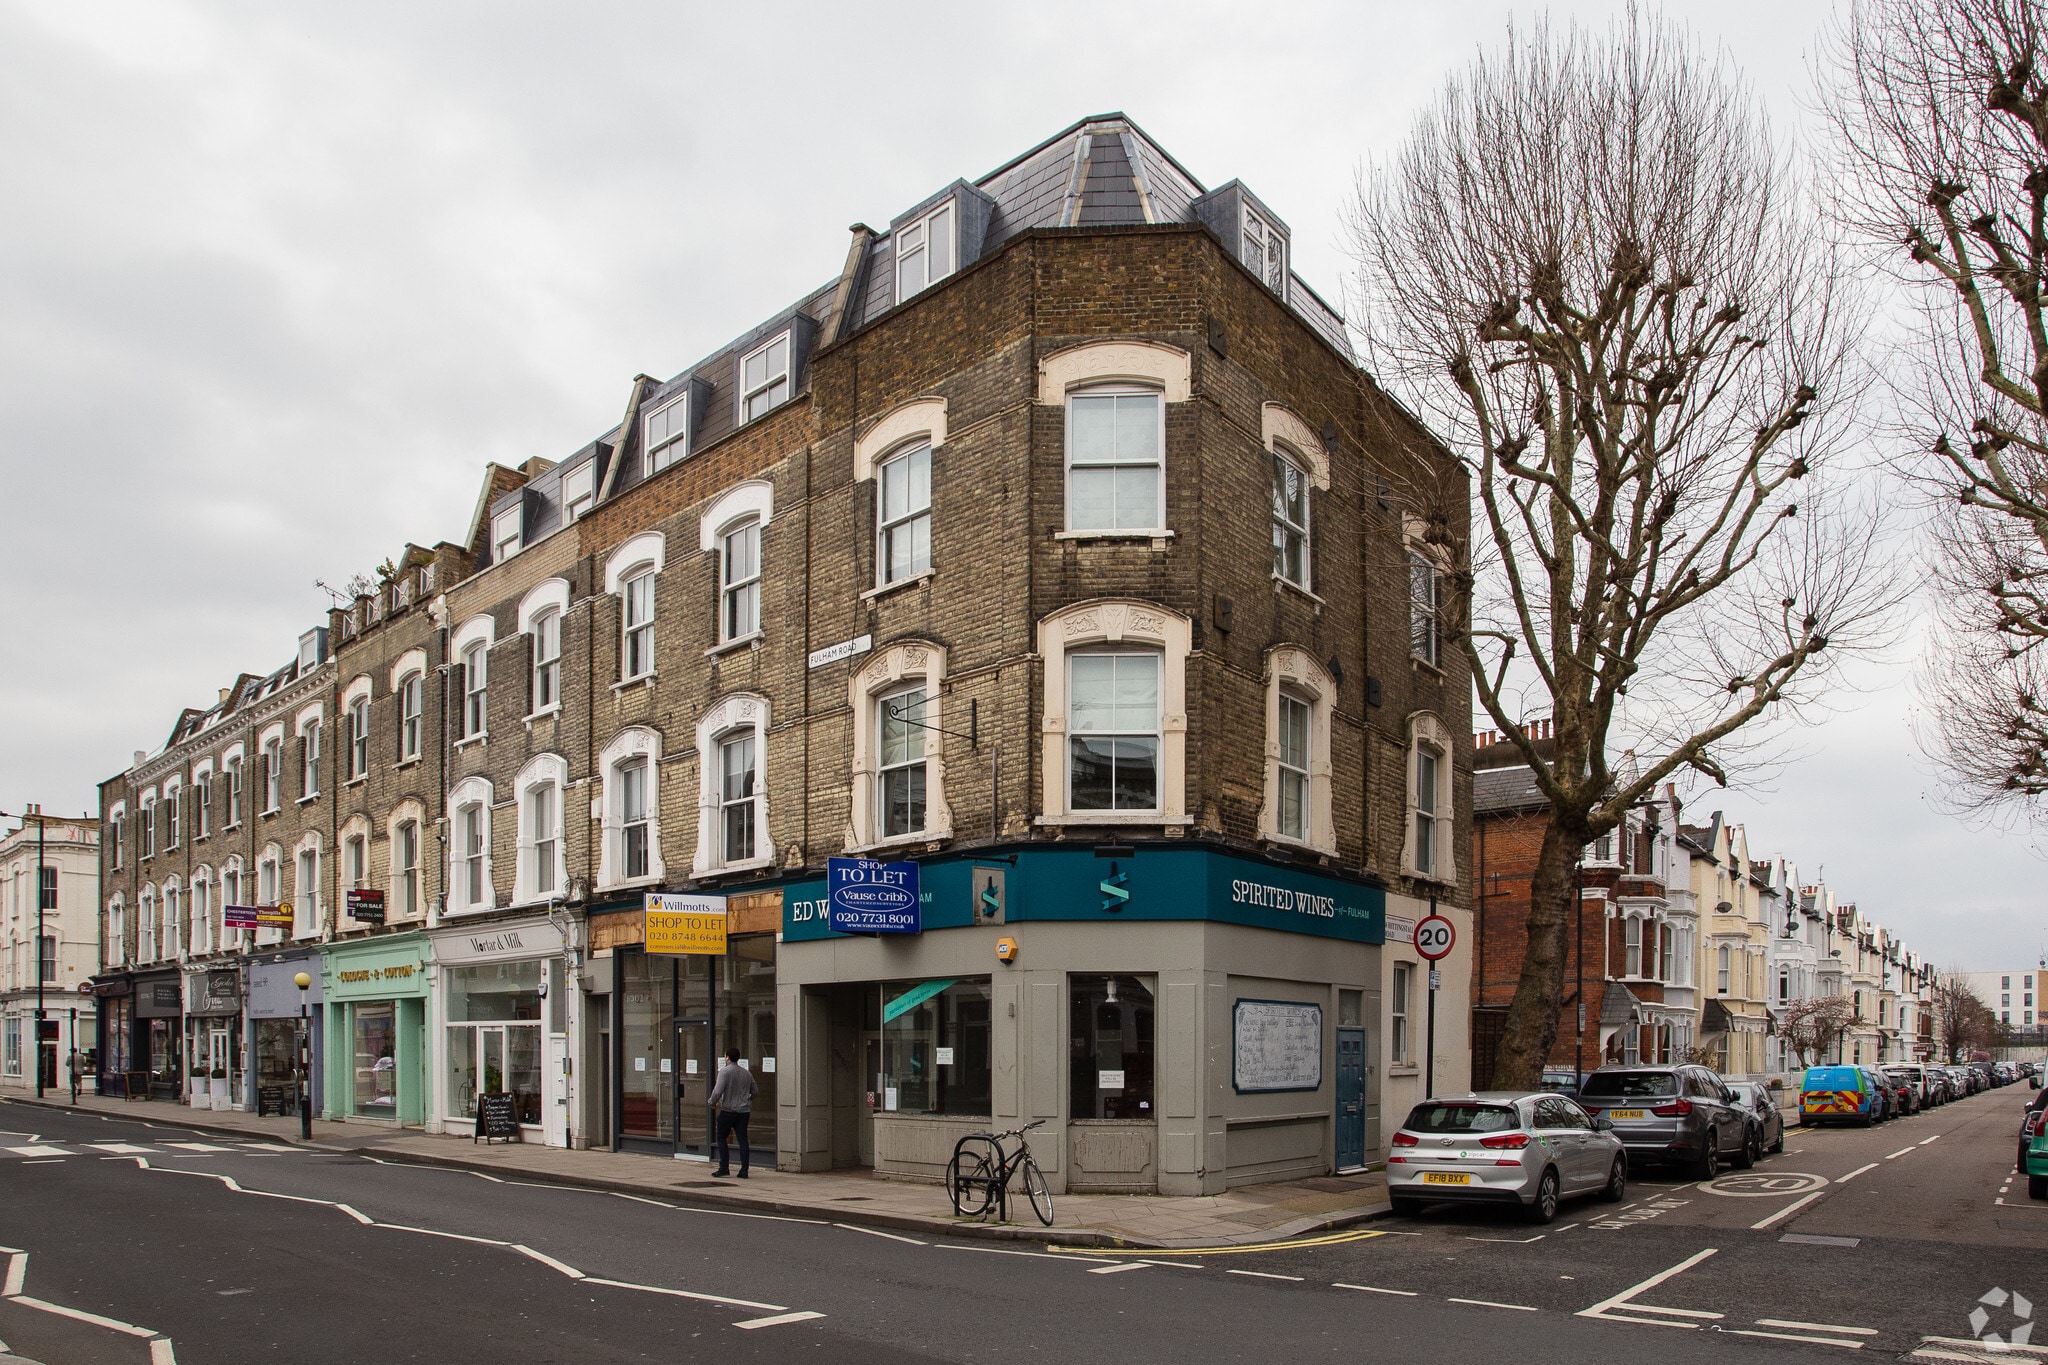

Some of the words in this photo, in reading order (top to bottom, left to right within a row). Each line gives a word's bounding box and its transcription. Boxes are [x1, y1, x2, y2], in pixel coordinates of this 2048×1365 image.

[810, 648, 837, 664] FULHAM
[838, 642, 857, 656] ROAD
[858, 860, 887, 870] SHOP
[838, 868, 865, 882] TO
[871, 870, 907, 884] LET
[842, 890, 877, 901] Vause
[878, 891, 907, 902] Cribb
[1232, 879, 1293, 911] SPIRITED
[1295, 891, 1334, 918] WINES
[1348, 907, 1370, 919] FULHAM
[649, 917, 682, 928] SHOP
[684, 918, 701, 930] TO
[705, 919, 723, 930] LET
[836, 912, 859, 923] 020
[861, 913, 886, 924] 7731
[888, 914, 914, 925] 8001
[503, 931, 524, 948] Milk
[649, 931, 668, 941] 020
[671, 932, 696, 941] 8748
[700, 933, 723, 942] 6644
[1420, 928, 1449, 946] 20
[1428, 1173, 1446, 1182] EF18
[1448, 1174, 1464, 1183] BXX
